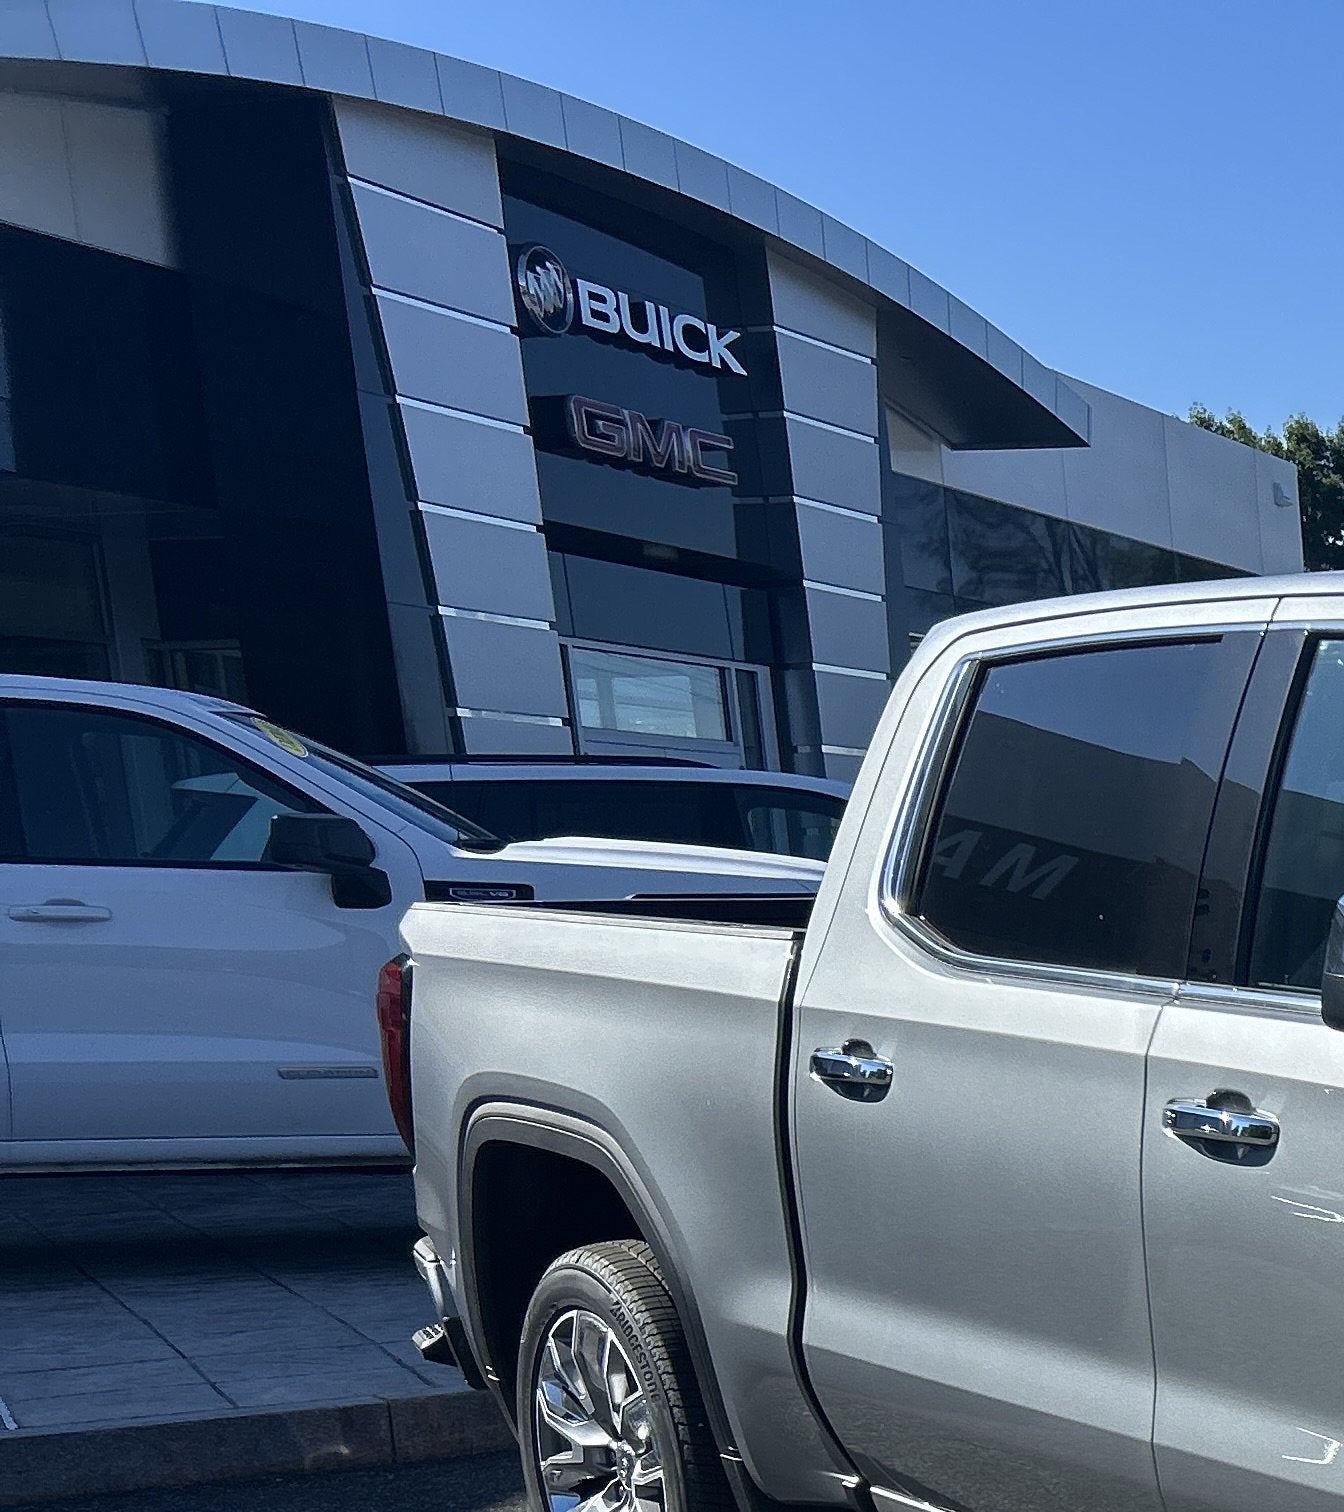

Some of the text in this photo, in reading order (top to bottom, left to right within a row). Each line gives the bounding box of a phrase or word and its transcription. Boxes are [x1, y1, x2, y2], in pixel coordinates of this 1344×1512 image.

[576, 278, 748, 377] BUICK
[569, 394, 738, 486] GMC
[609, 1300, 661, 1401] BRIDGESTONE
